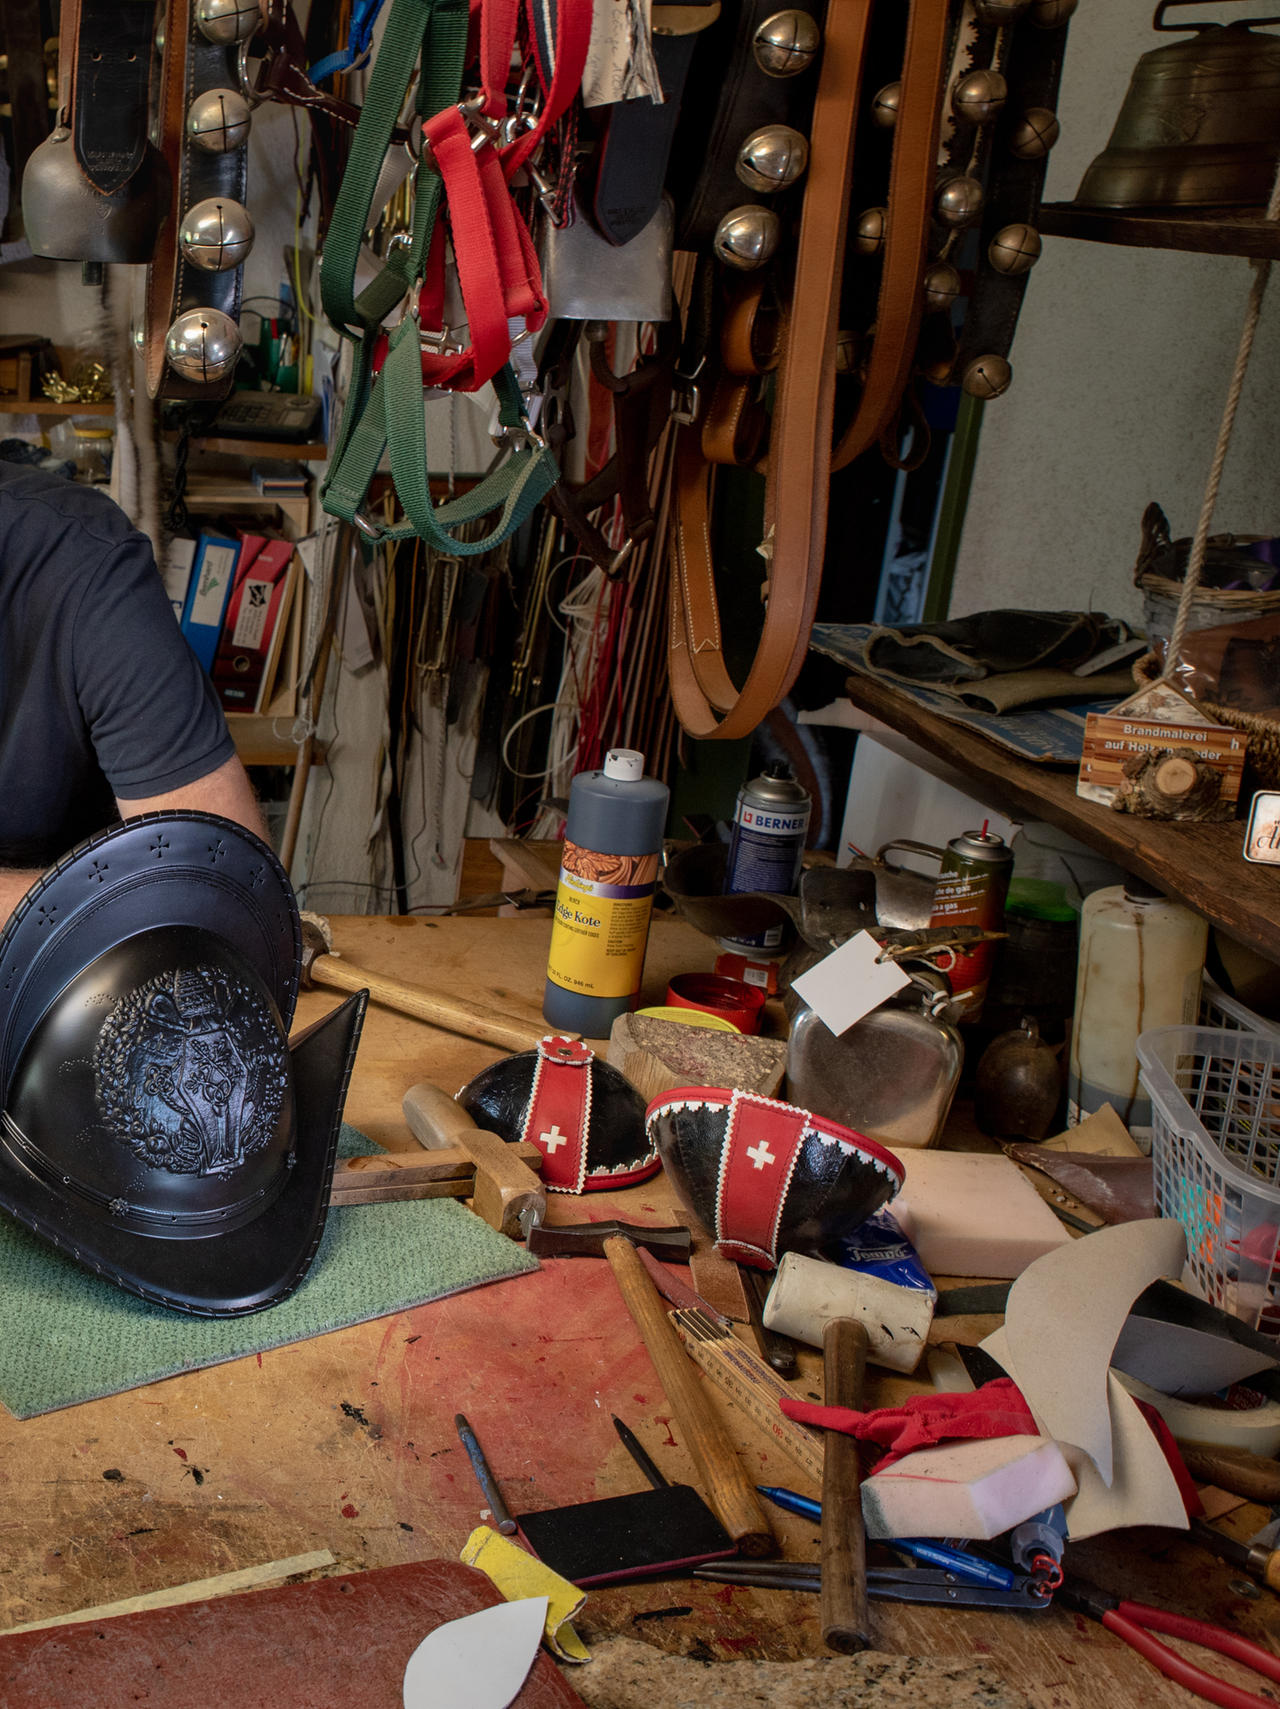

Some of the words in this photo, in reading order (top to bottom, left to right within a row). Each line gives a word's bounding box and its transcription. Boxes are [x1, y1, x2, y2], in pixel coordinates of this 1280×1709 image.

[1123, 724, 1208, 742] Brandmalerei
[1104, 739, 1125, 751] auf
[755, 814, 806, 830] BERNER
[574, 910, 601, 928] Kote
